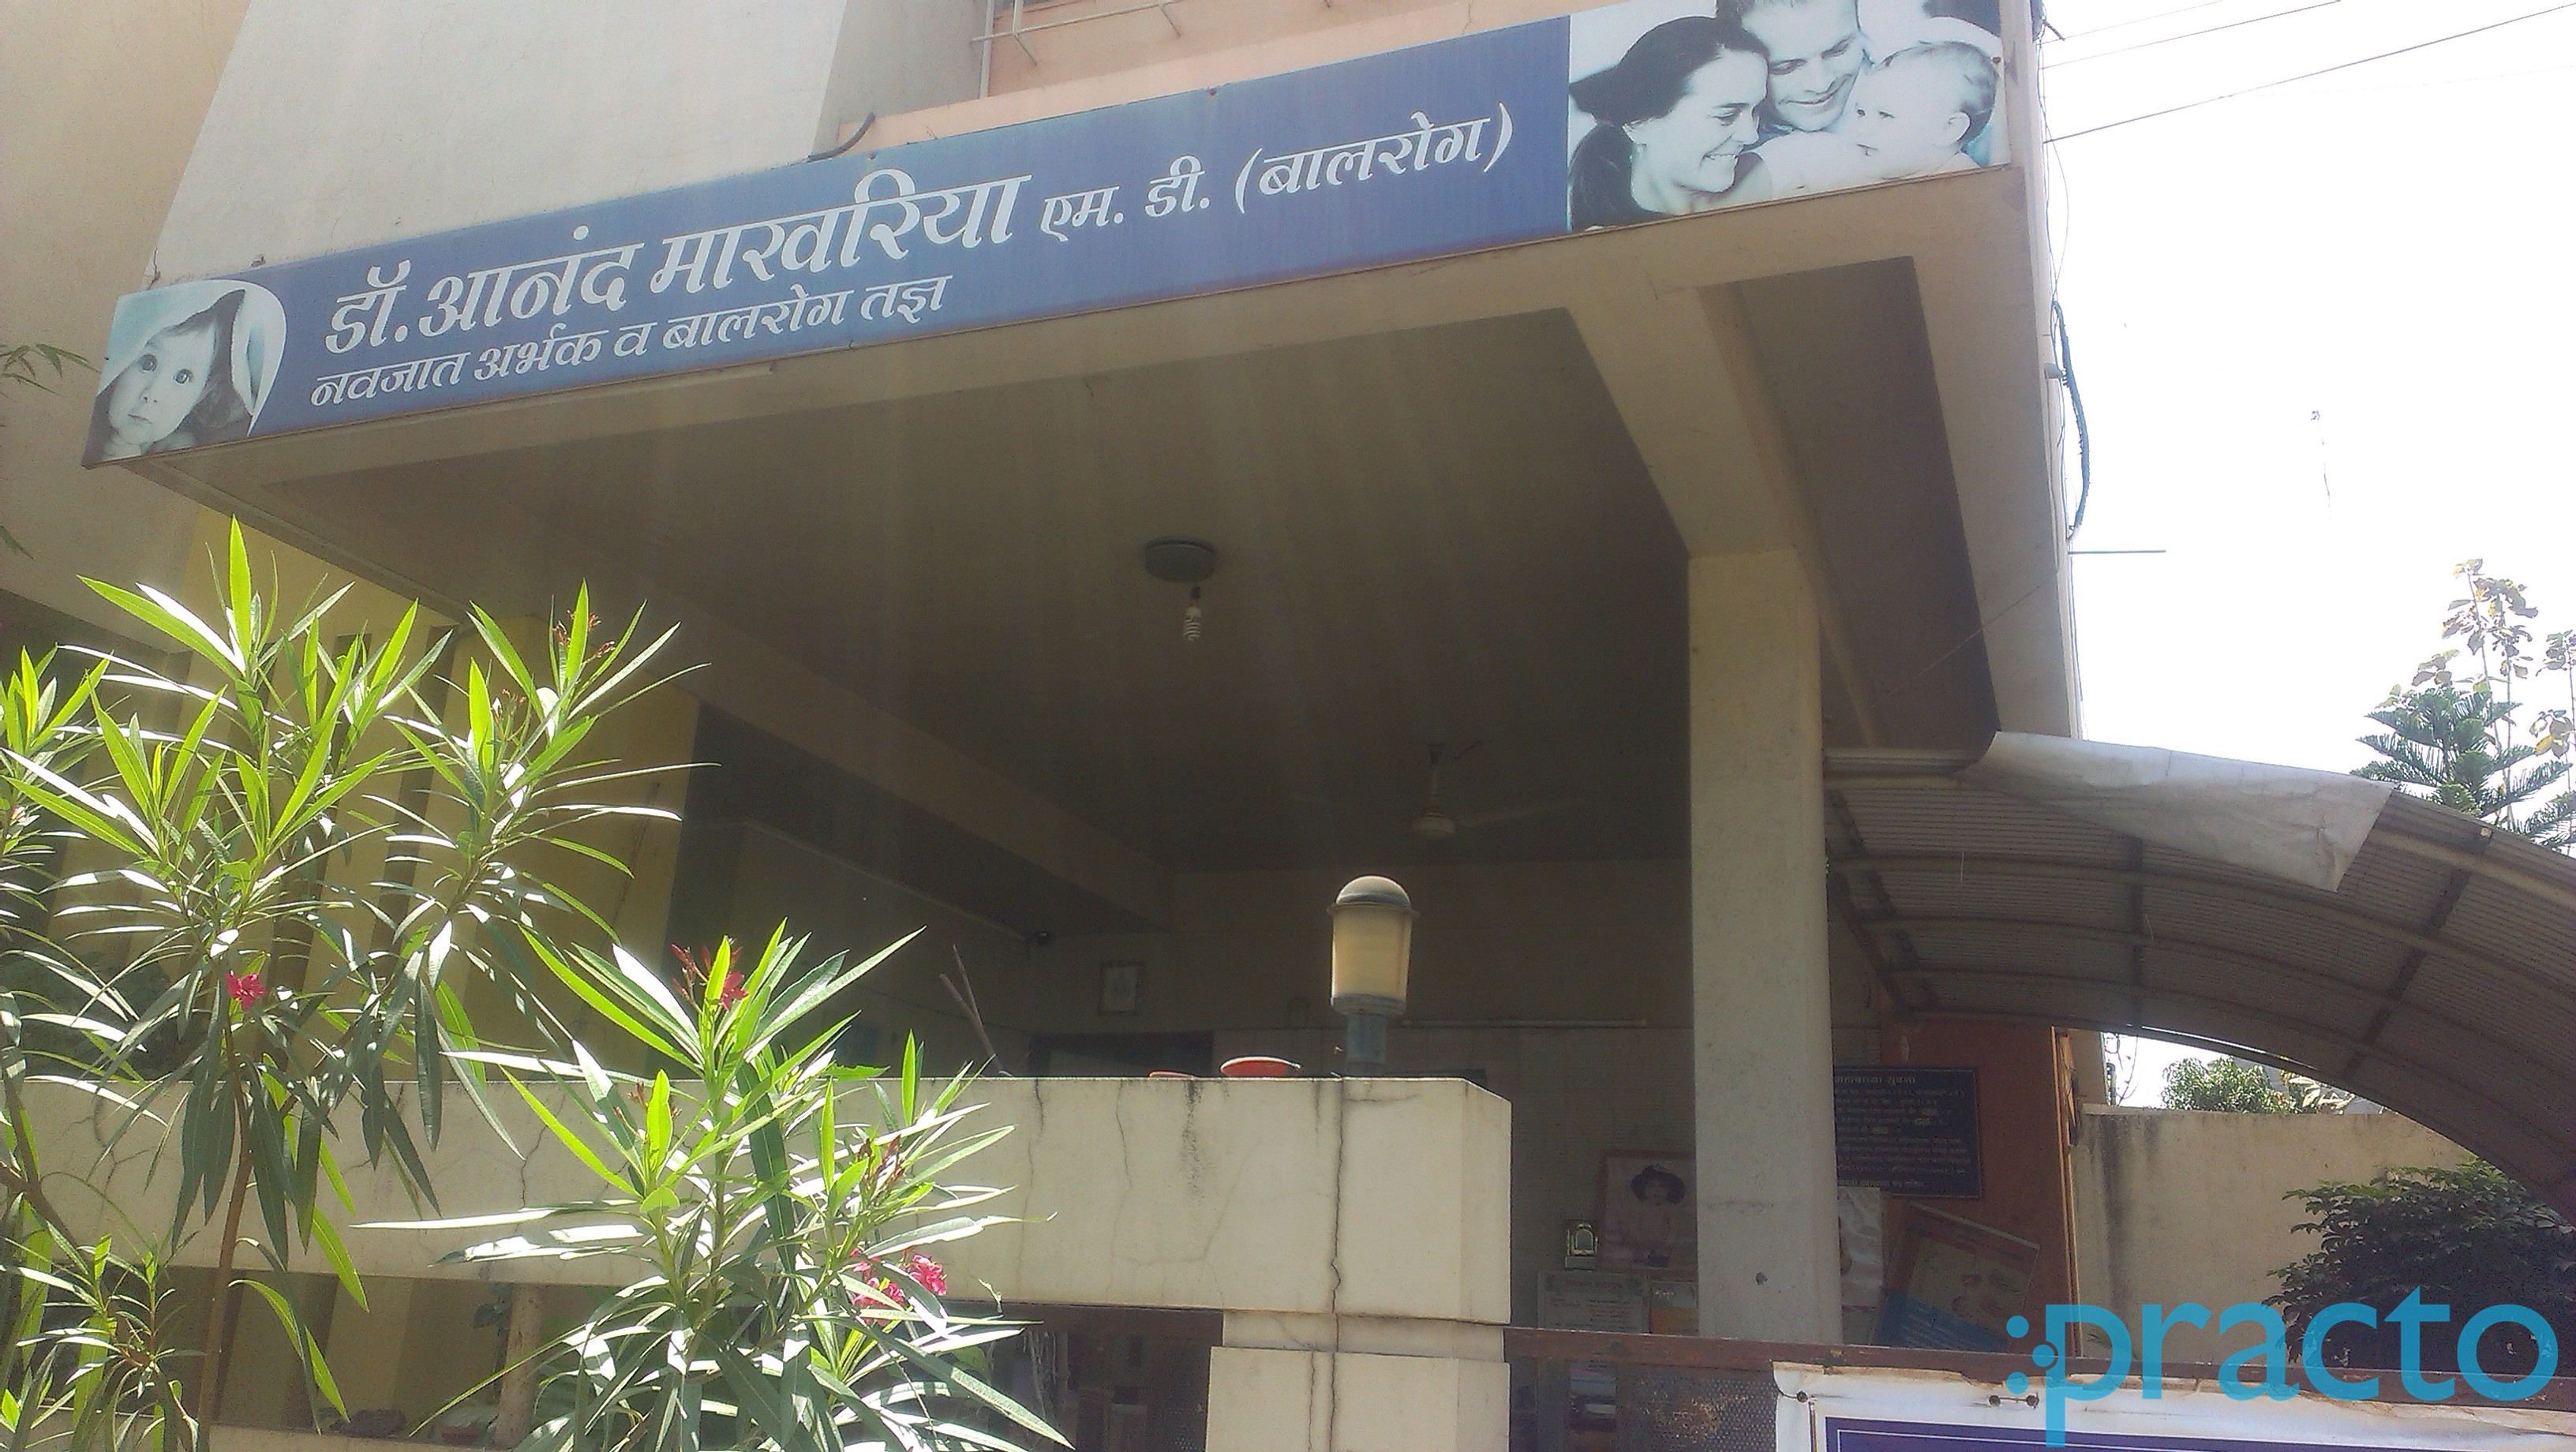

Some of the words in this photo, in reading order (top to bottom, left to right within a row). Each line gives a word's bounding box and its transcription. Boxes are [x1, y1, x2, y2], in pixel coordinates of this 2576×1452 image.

[325, 259, 411, 354] डॉ.
[418, 225, 645, 337] आनंद
[1040, 186, 1125, 242] एम.
[1144, 155, 1211, 218] डी.
[1234, 102, 1514, 215] (बालरोग)
[310, 351, 472, 406] नवजात
[473, 322, 610, 381] अर्भक
[613, 320, 658, 357] व
[661, 283, 855, 350] बालरोग
[860, 275, 954, 324] तज्ञ
